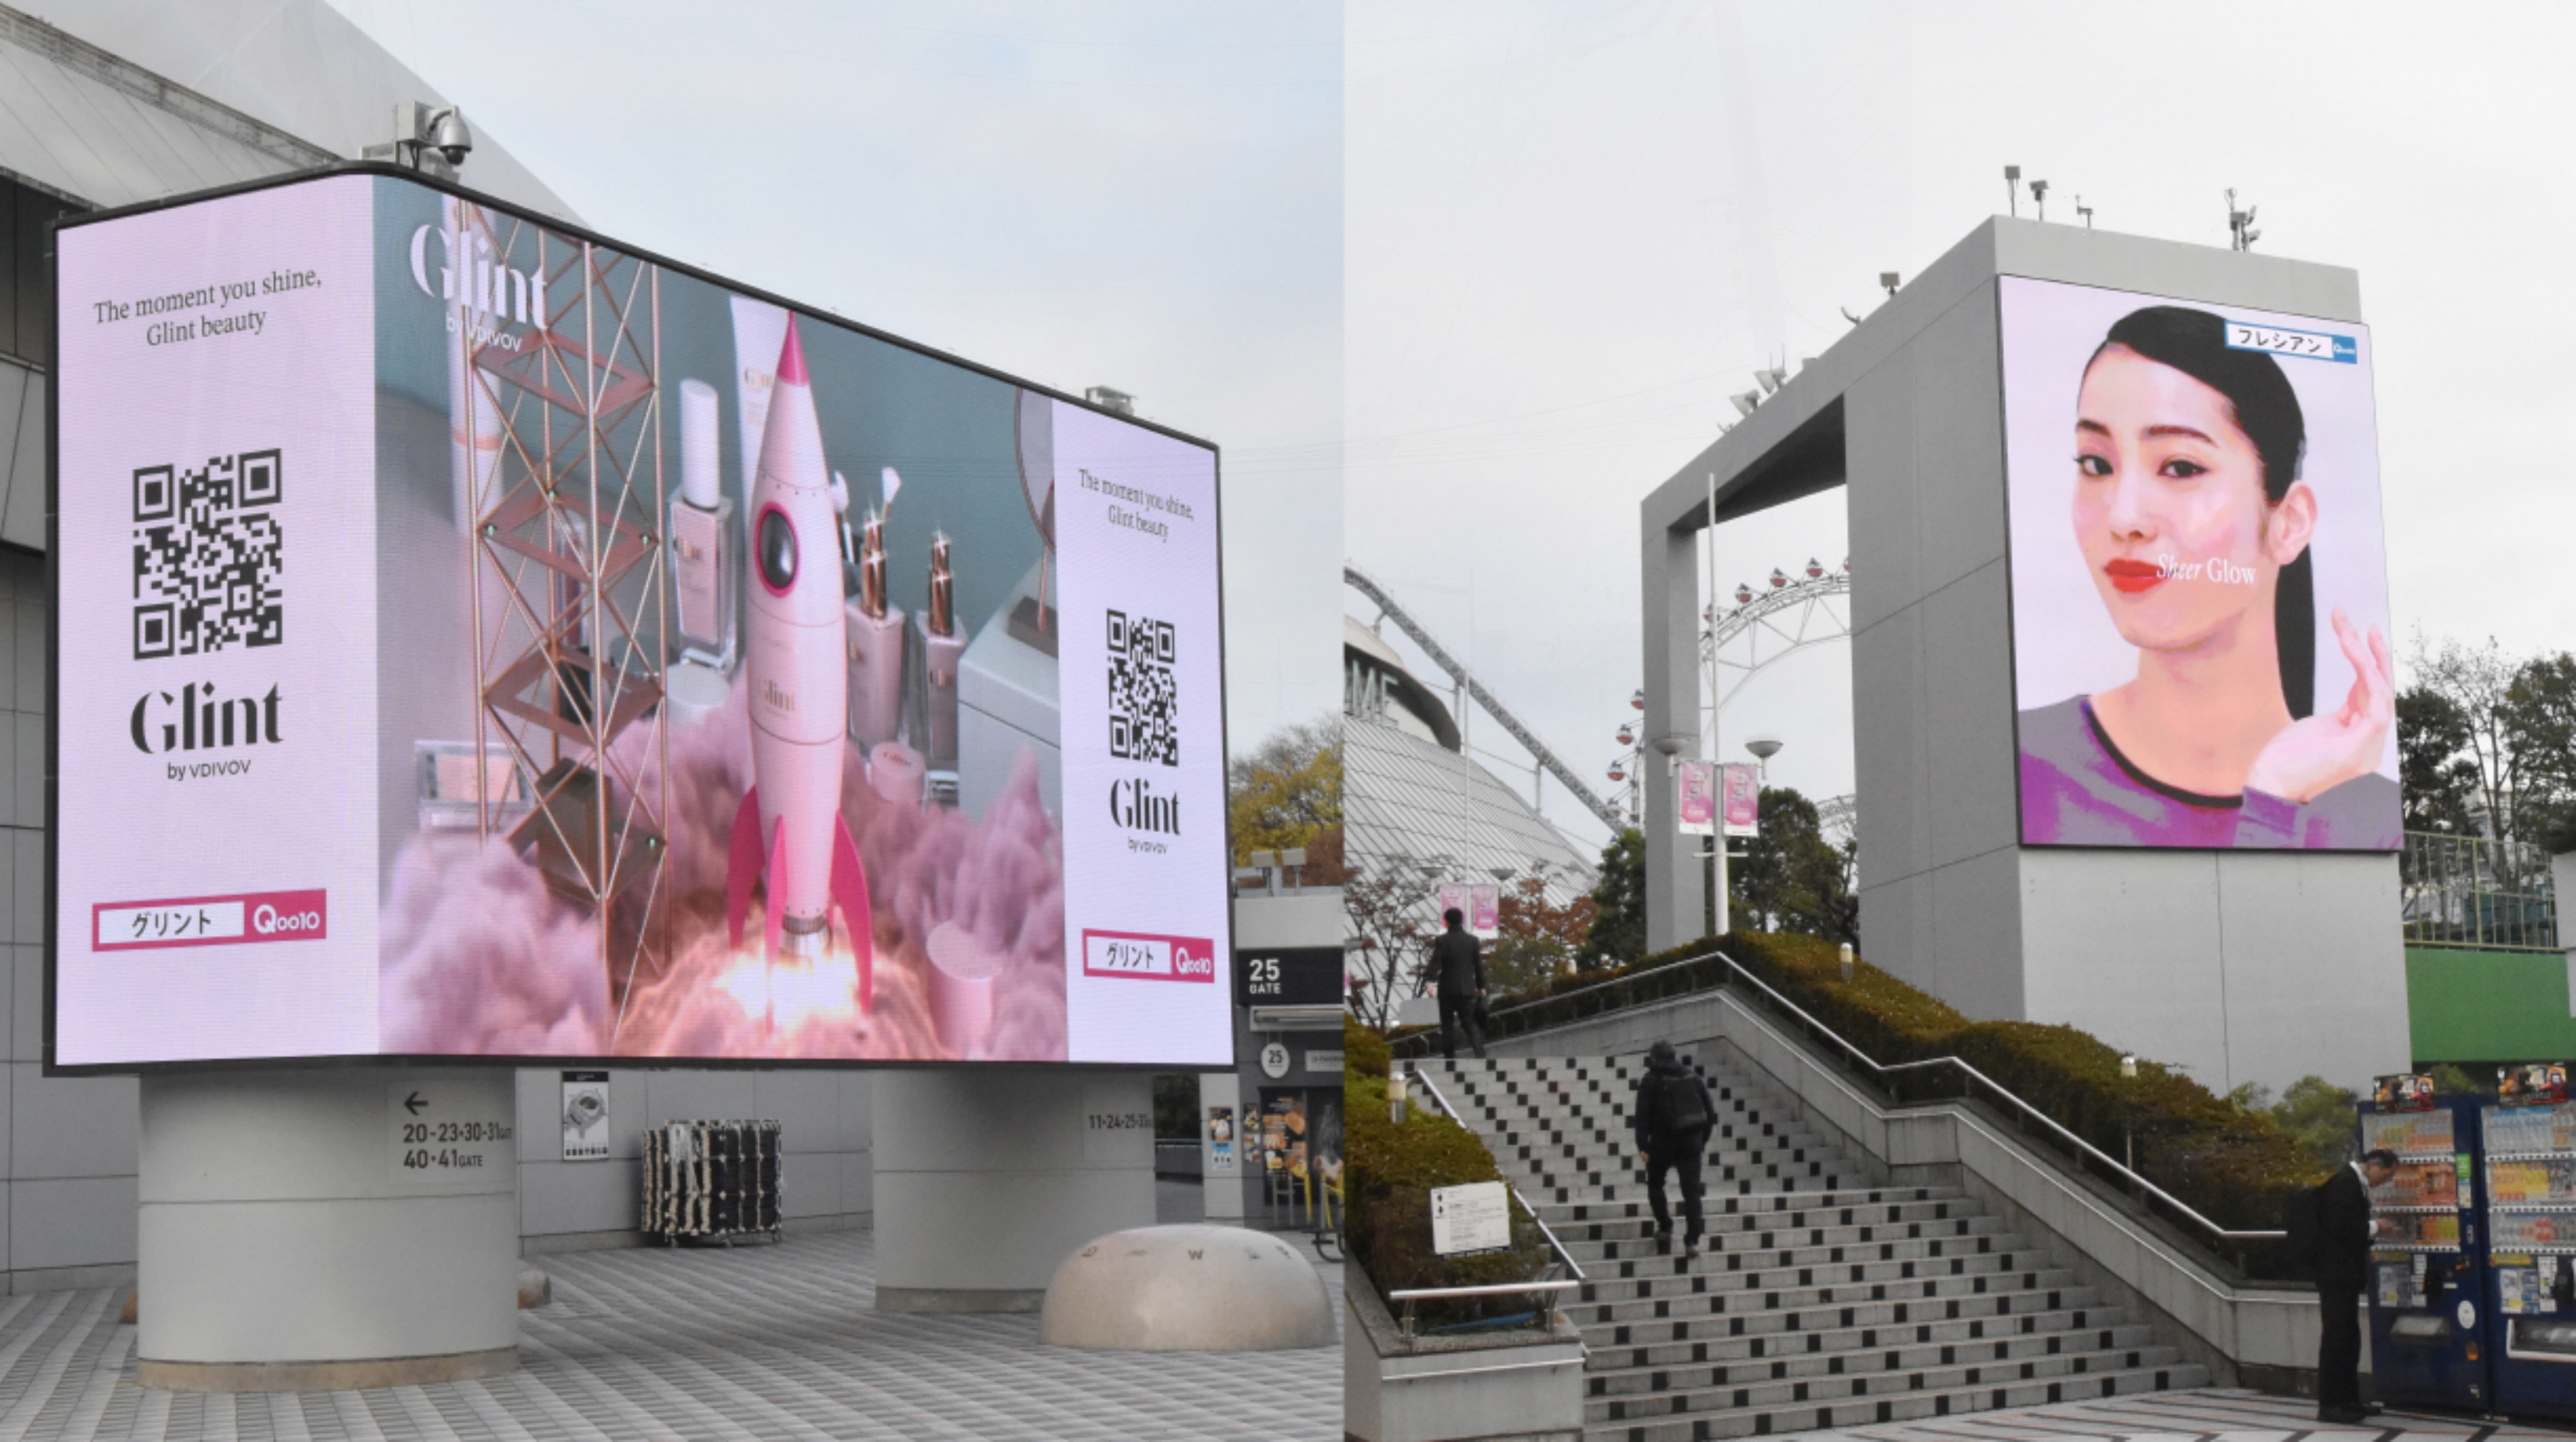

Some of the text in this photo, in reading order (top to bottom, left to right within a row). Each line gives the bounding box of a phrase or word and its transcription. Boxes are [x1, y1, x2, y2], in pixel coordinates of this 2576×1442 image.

[410, 224, 548, 330] Glint
[93, 268, 322, 324] The moment you shine,
[146, 310, 267, 346] Glint beauty
[2238, 329, 2322, 354] フレシアン
[1078, 468, 1099, 491] The
[1102, 479, 1144, 505] moment
[1145, 492, 1164, 512] you
[1108, 504, 1169, 543] Glint beauty
[2156, 553, 2256, 584] Sheer Glow
[130, 681, 285, 754] Glint
[167, 760, 252, 782] by VDIVOV
[1110, 778, 1181, 836] Glint
[132, 909, 211, 938] グリント
[253, 903, 320, 935] Qoo10
[1107, 942, 1154, 969] グリント
[1249, 958, 1281, 982] 25
[1249, 982, 1282, 995] GATE
[1268, 1050, 1283, 1064] 25
